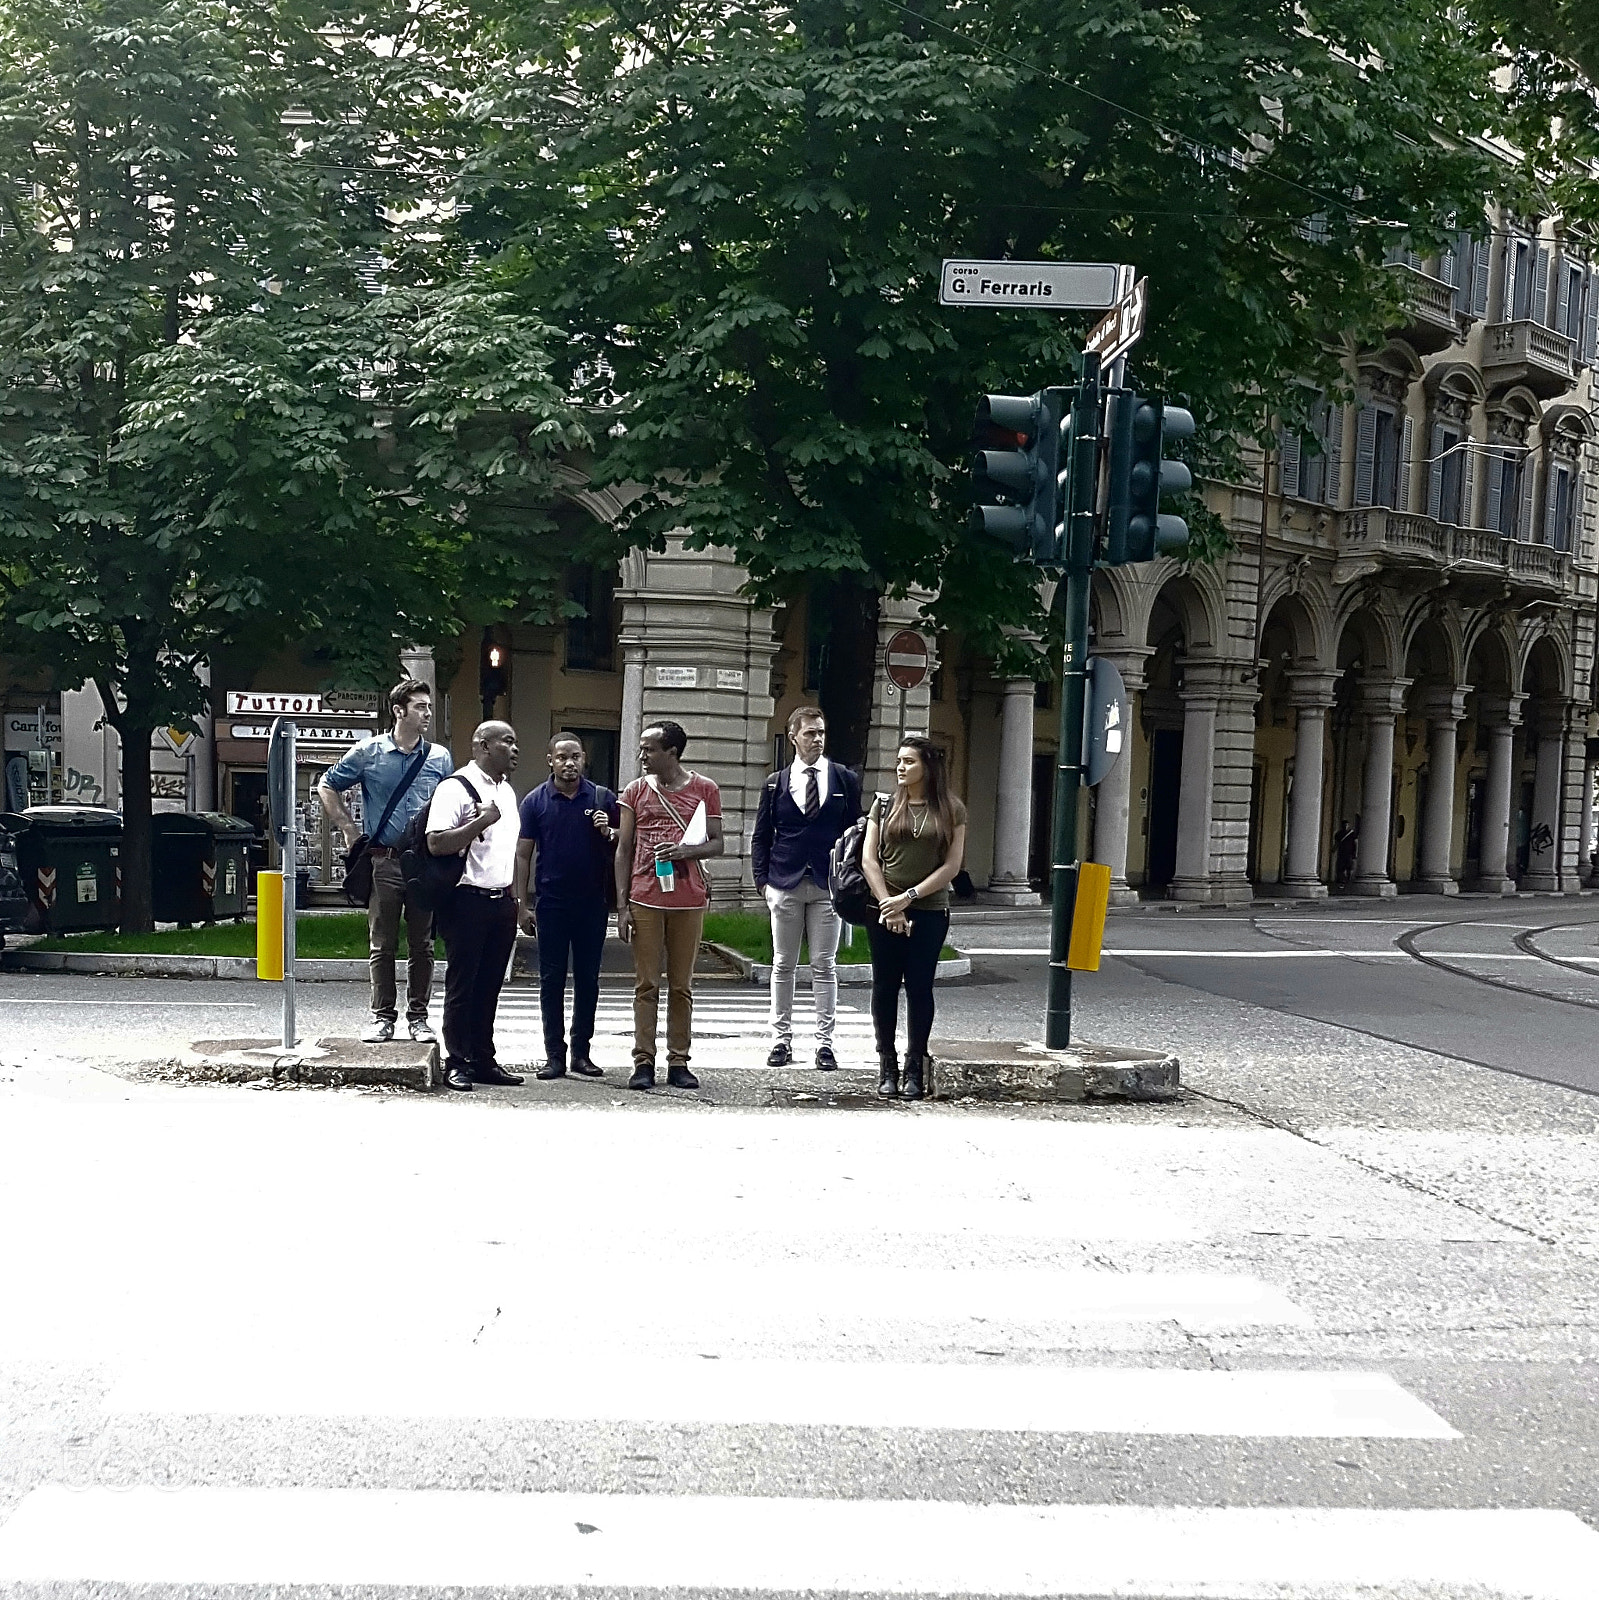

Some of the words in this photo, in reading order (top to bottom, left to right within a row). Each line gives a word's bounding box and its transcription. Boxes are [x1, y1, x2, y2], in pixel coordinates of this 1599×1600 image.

[952, 278, 971, 294] G.
[980, 280, 1053, 296] Ferraris
[297, 728, 355, 739] TAMPA
